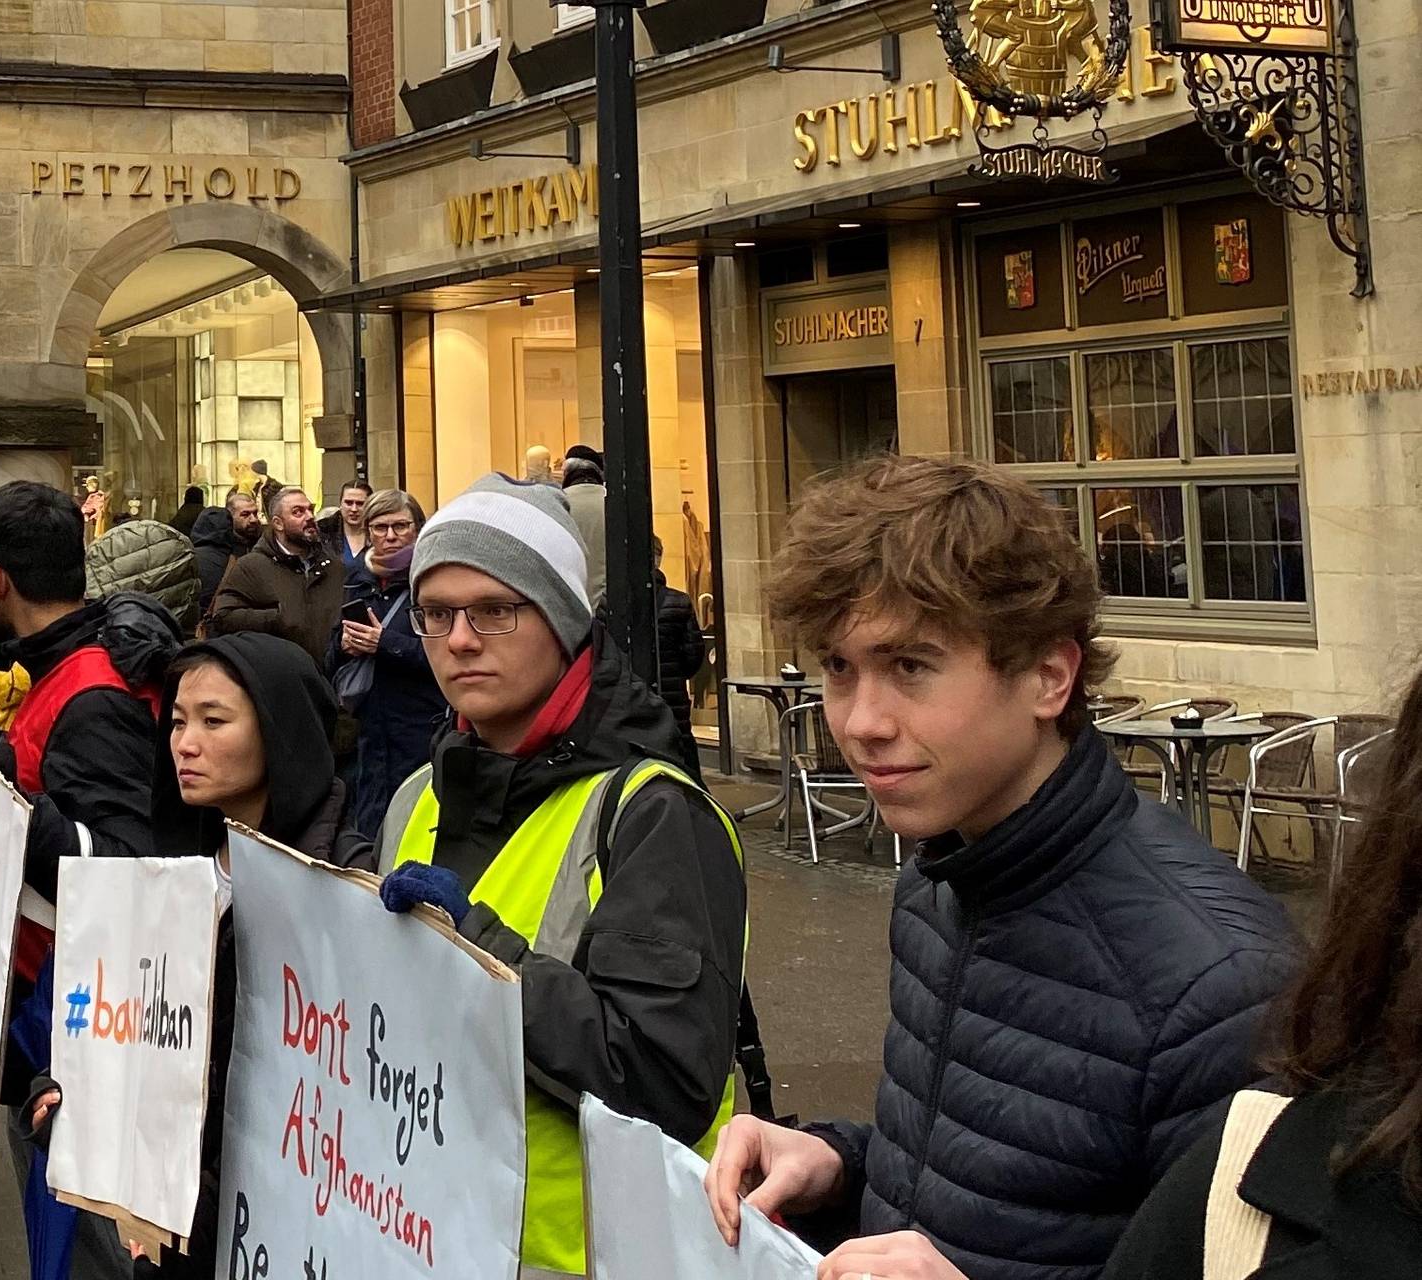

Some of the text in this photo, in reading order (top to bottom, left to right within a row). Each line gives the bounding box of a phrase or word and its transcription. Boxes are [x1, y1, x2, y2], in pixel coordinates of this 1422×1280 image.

[1209, 1, 1297, 26] UNION-BIER
[31, 161, 301, 200] PETZHOLD
[981, 148, 1106, 181] STUHLMACHER
[446, 160, 599, 246] WEITKAM
[1076, 234, 1142, 294] Pilsner
[774, 305, 890, 346] STUHLMACHER
[283, 963, 444, 1165] Don't forget
[282, 1077, 433, 1268] Afghanistan
[229, 1190, 269, 1280] Be
